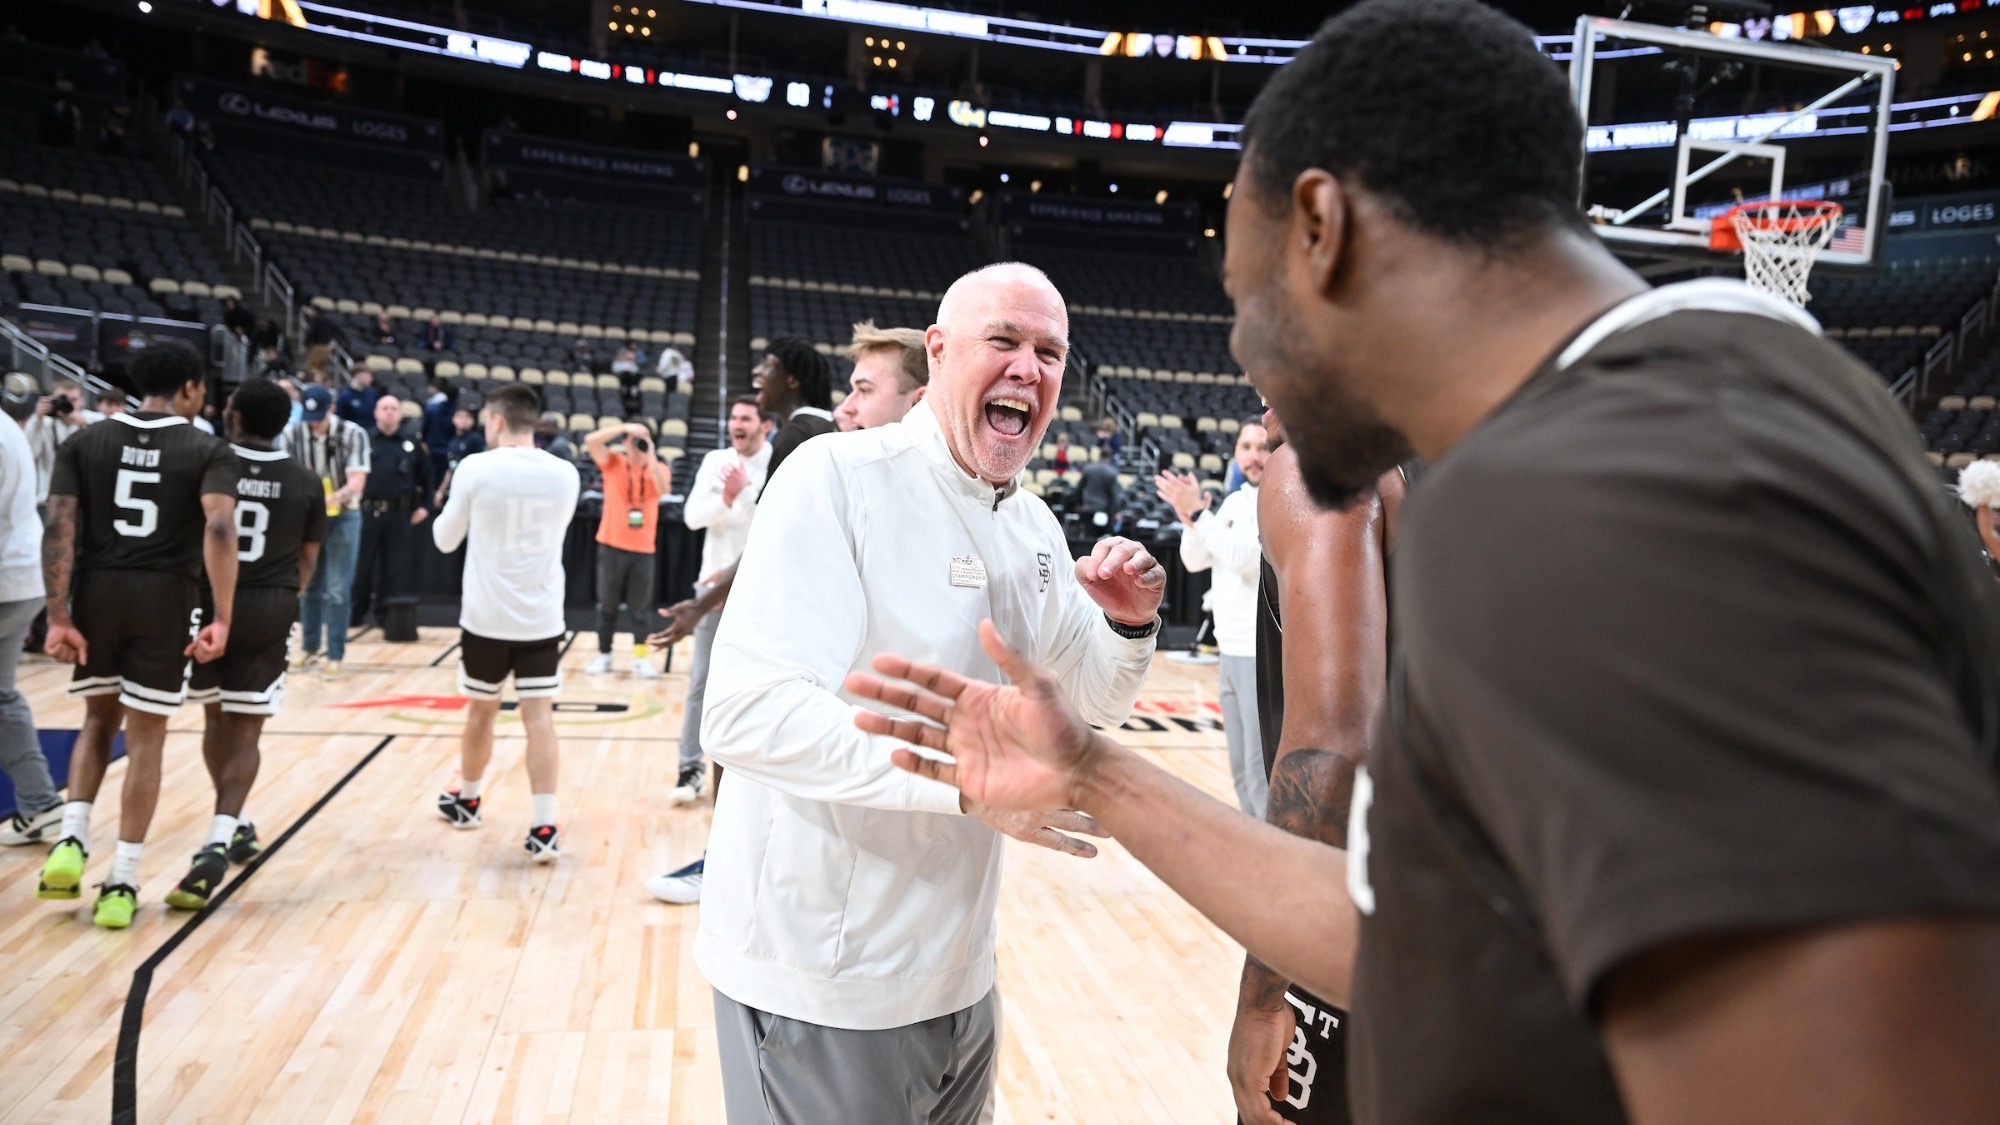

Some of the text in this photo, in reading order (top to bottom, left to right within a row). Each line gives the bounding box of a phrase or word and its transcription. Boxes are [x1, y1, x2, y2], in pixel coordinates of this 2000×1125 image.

[253, 103, 408, 142] LEXUS LOGES
[809, 180, 876, 199] LEXUS
[1932, 203, 1995, 225] LOGES
[121, 445, 161, 467] BOWEN
[113, 468, 161, 537] 5
[502, 497, 555, 554] 15
